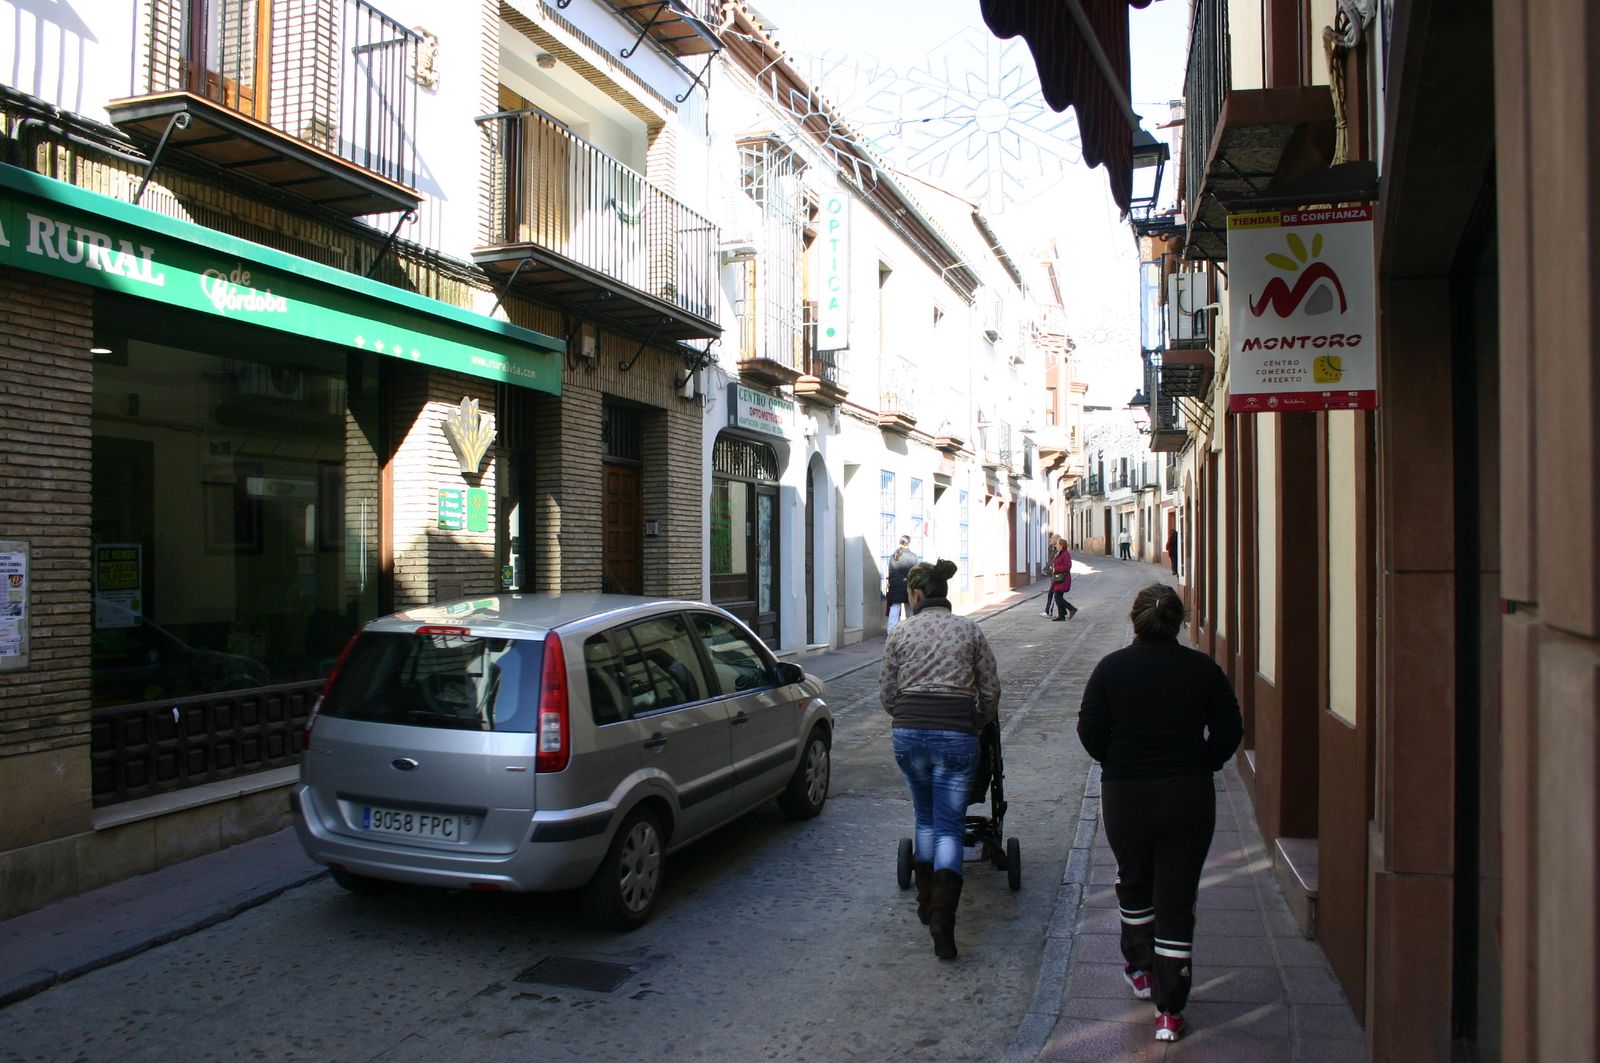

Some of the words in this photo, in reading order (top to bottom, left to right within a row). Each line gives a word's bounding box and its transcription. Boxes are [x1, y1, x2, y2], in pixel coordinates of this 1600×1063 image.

[1231, 215, 1280, 226] TIENDAS
[1283, 214, 1298, 223] DE
[1301, 209, 1367, 222] CONFIANZA
[26, 213, 164, 287] RURAL
[828, 198, 841, 311] OPTICA
[231, 263, 251, 286] de
[1241, 333, 1362, 352] MONTORO
[1256, 368, 1308, 376] COMERCIAL
[1262, 376, 1302, 384] ABIERTO
[739, 388, 766, 407] CENTRO
[373, 810, 414, 832] 9058
[419, 815, 453, 836] FPC
